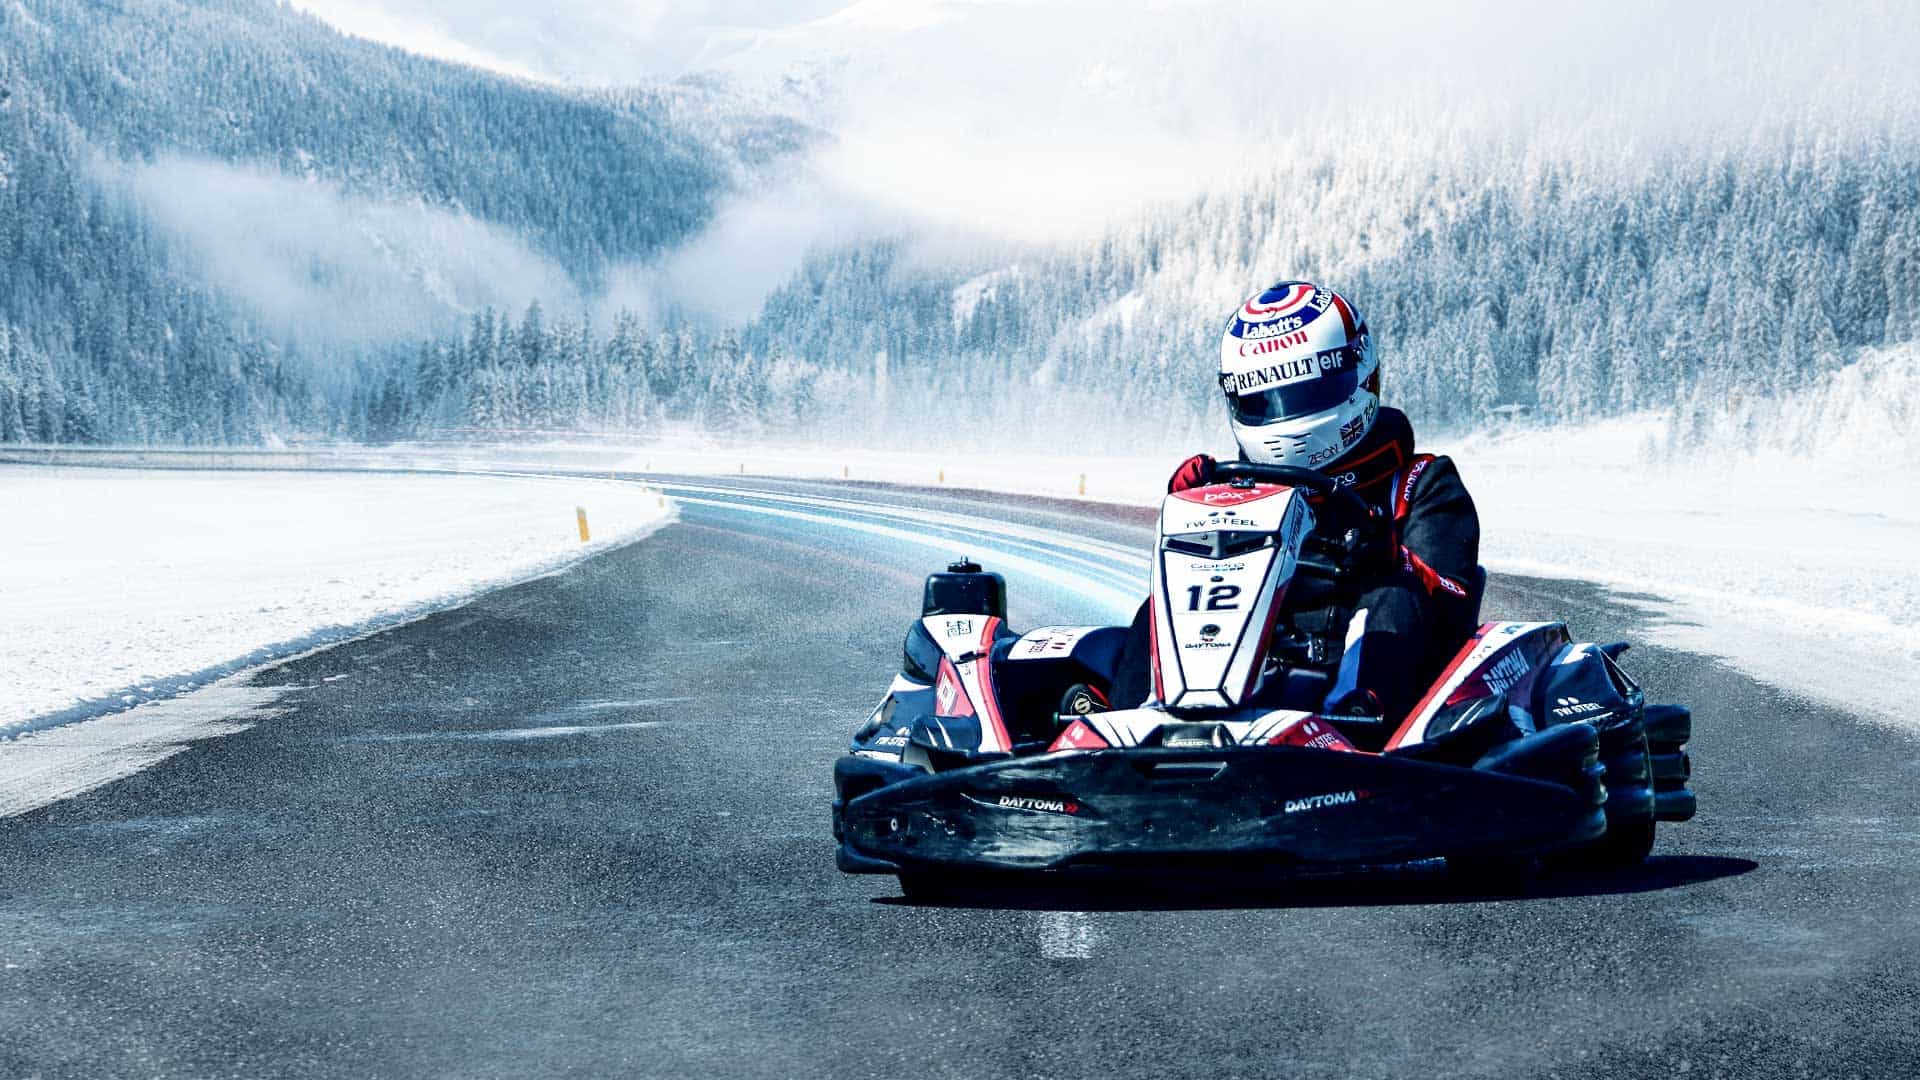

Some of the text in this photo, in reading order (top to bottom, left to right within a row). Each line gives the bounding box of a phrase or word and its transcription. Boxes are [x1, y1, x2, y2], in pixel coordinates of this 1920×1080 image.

[1241, 315, 1304, 339] Labatt's
[1239, 331, 1309, 357] Canon
[1238, 358, 1314, 390] RENAULT
[1320, 351, 1344, 370] elf
[1186, 517, 1259, 529] TW STEEL
[1186, 584, 1242, 612] 12
[1184, 641, 1232, 650] DAYTONA
[1552, 702, 1606, 718] TW STEEL
[999, 796, 1064, 812] DAYTONA
[1284, 790, 1357, 813] DAYTONA
